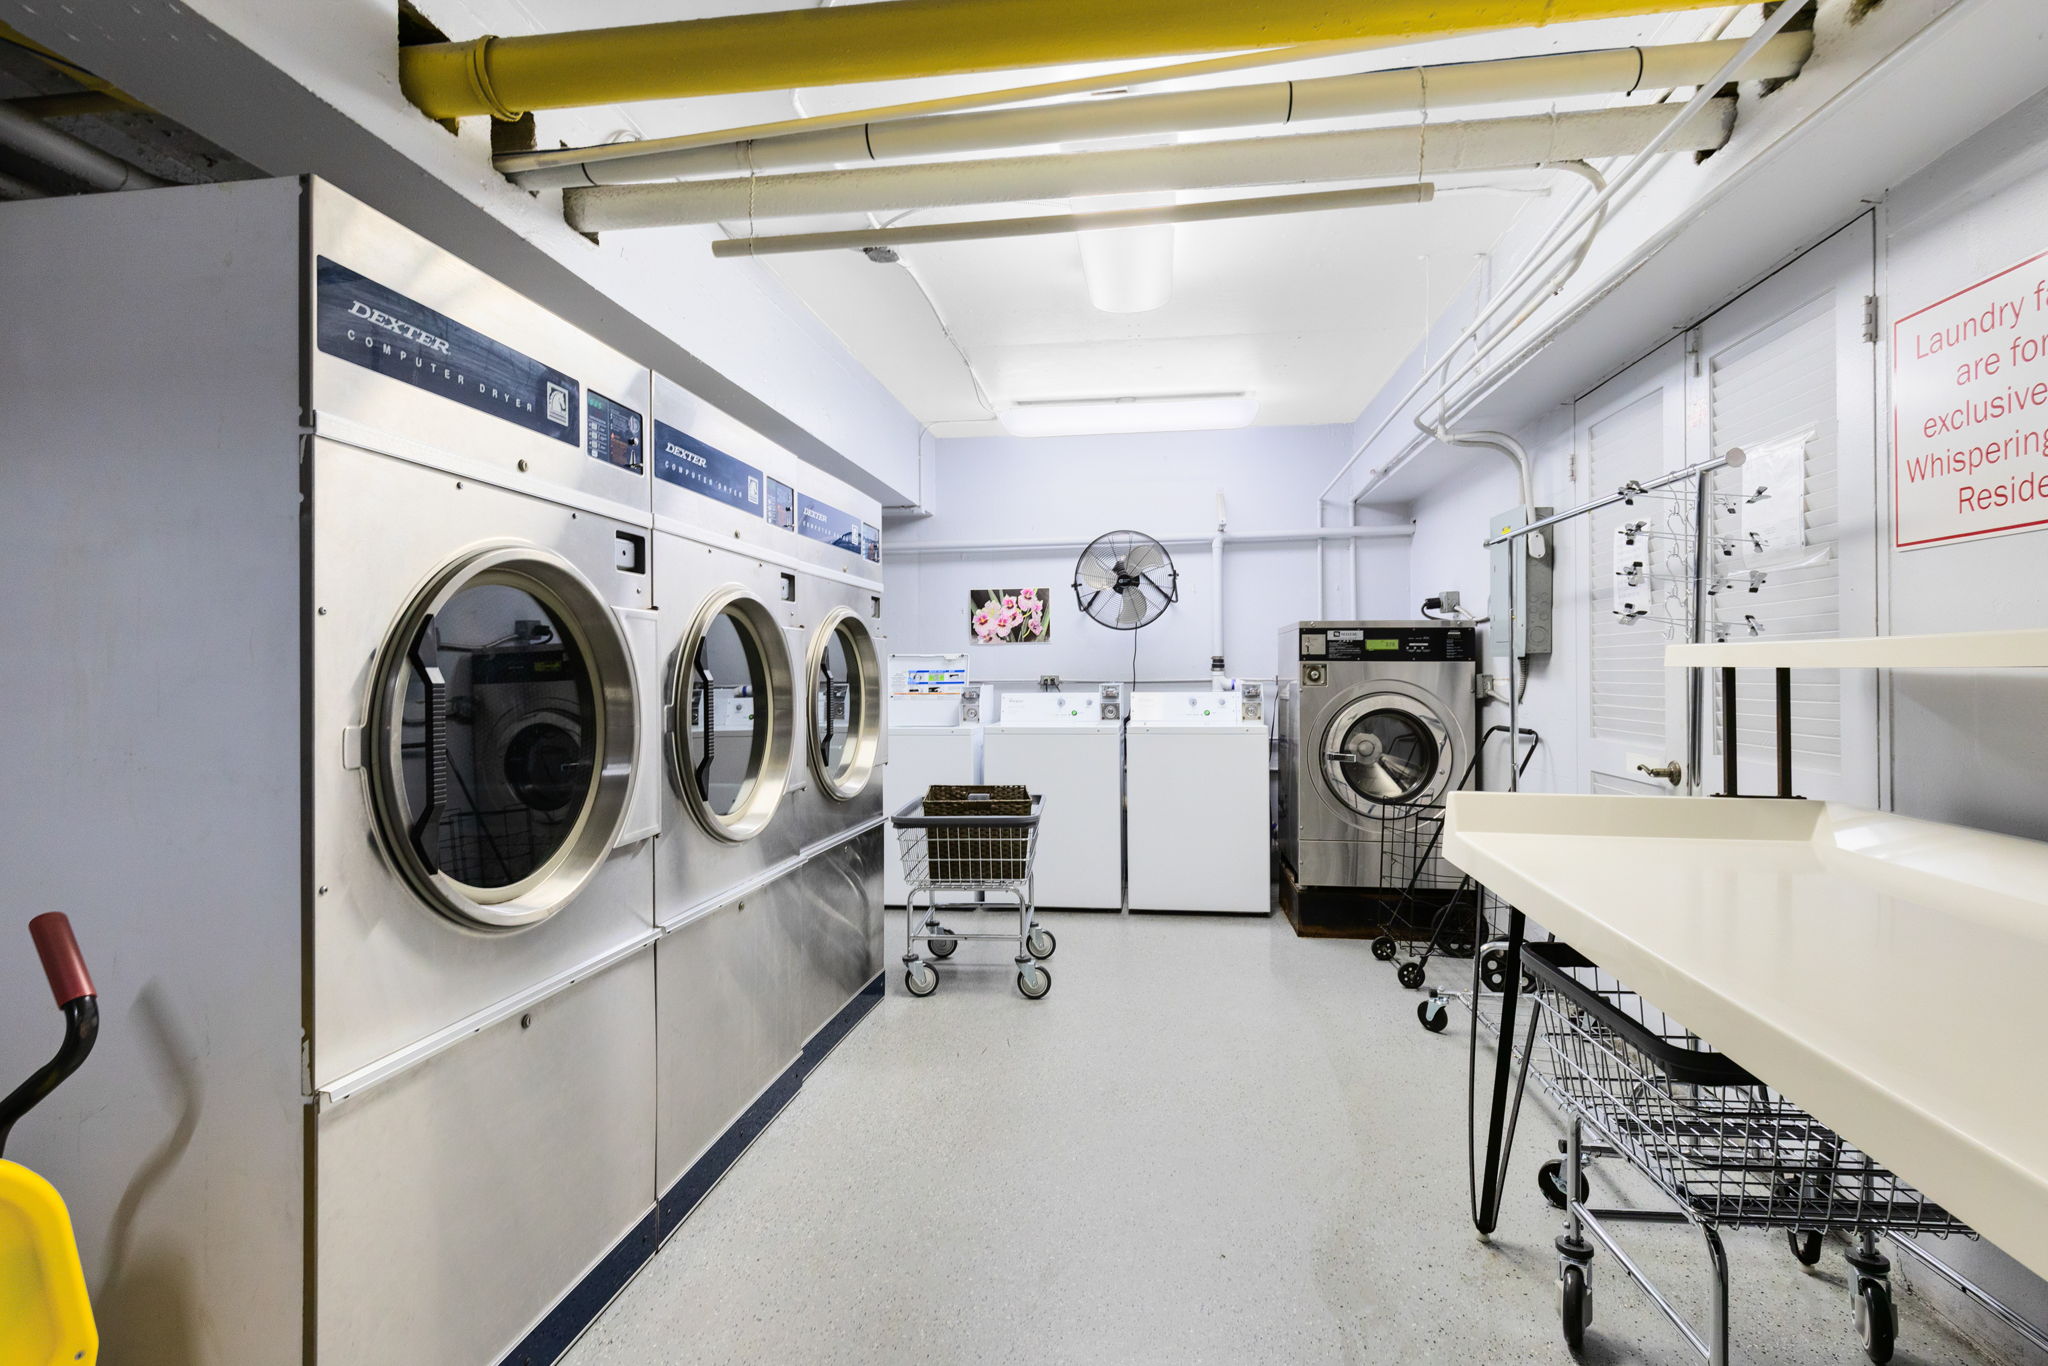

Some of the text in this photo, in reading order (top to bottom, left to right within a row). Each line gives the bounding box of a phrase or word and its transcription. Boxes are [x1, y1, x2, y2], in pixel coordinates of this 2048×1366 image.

[347, 300, 452, 355] DEXTER
[1916, 279, 2048, 360] Laundry f
[347, 329, 534, 414] COMPUTER DRYER
[1956, 334, 2048, 386] are for
[1923, 382, 2048, 439] exclusive
[664, 460, 713, 486] COMPUTER
[665, 442, 707, 469] DEXTER
[803, 507, 828, 522] DEXTER
[1958, 472, 2048, 514] Reside
